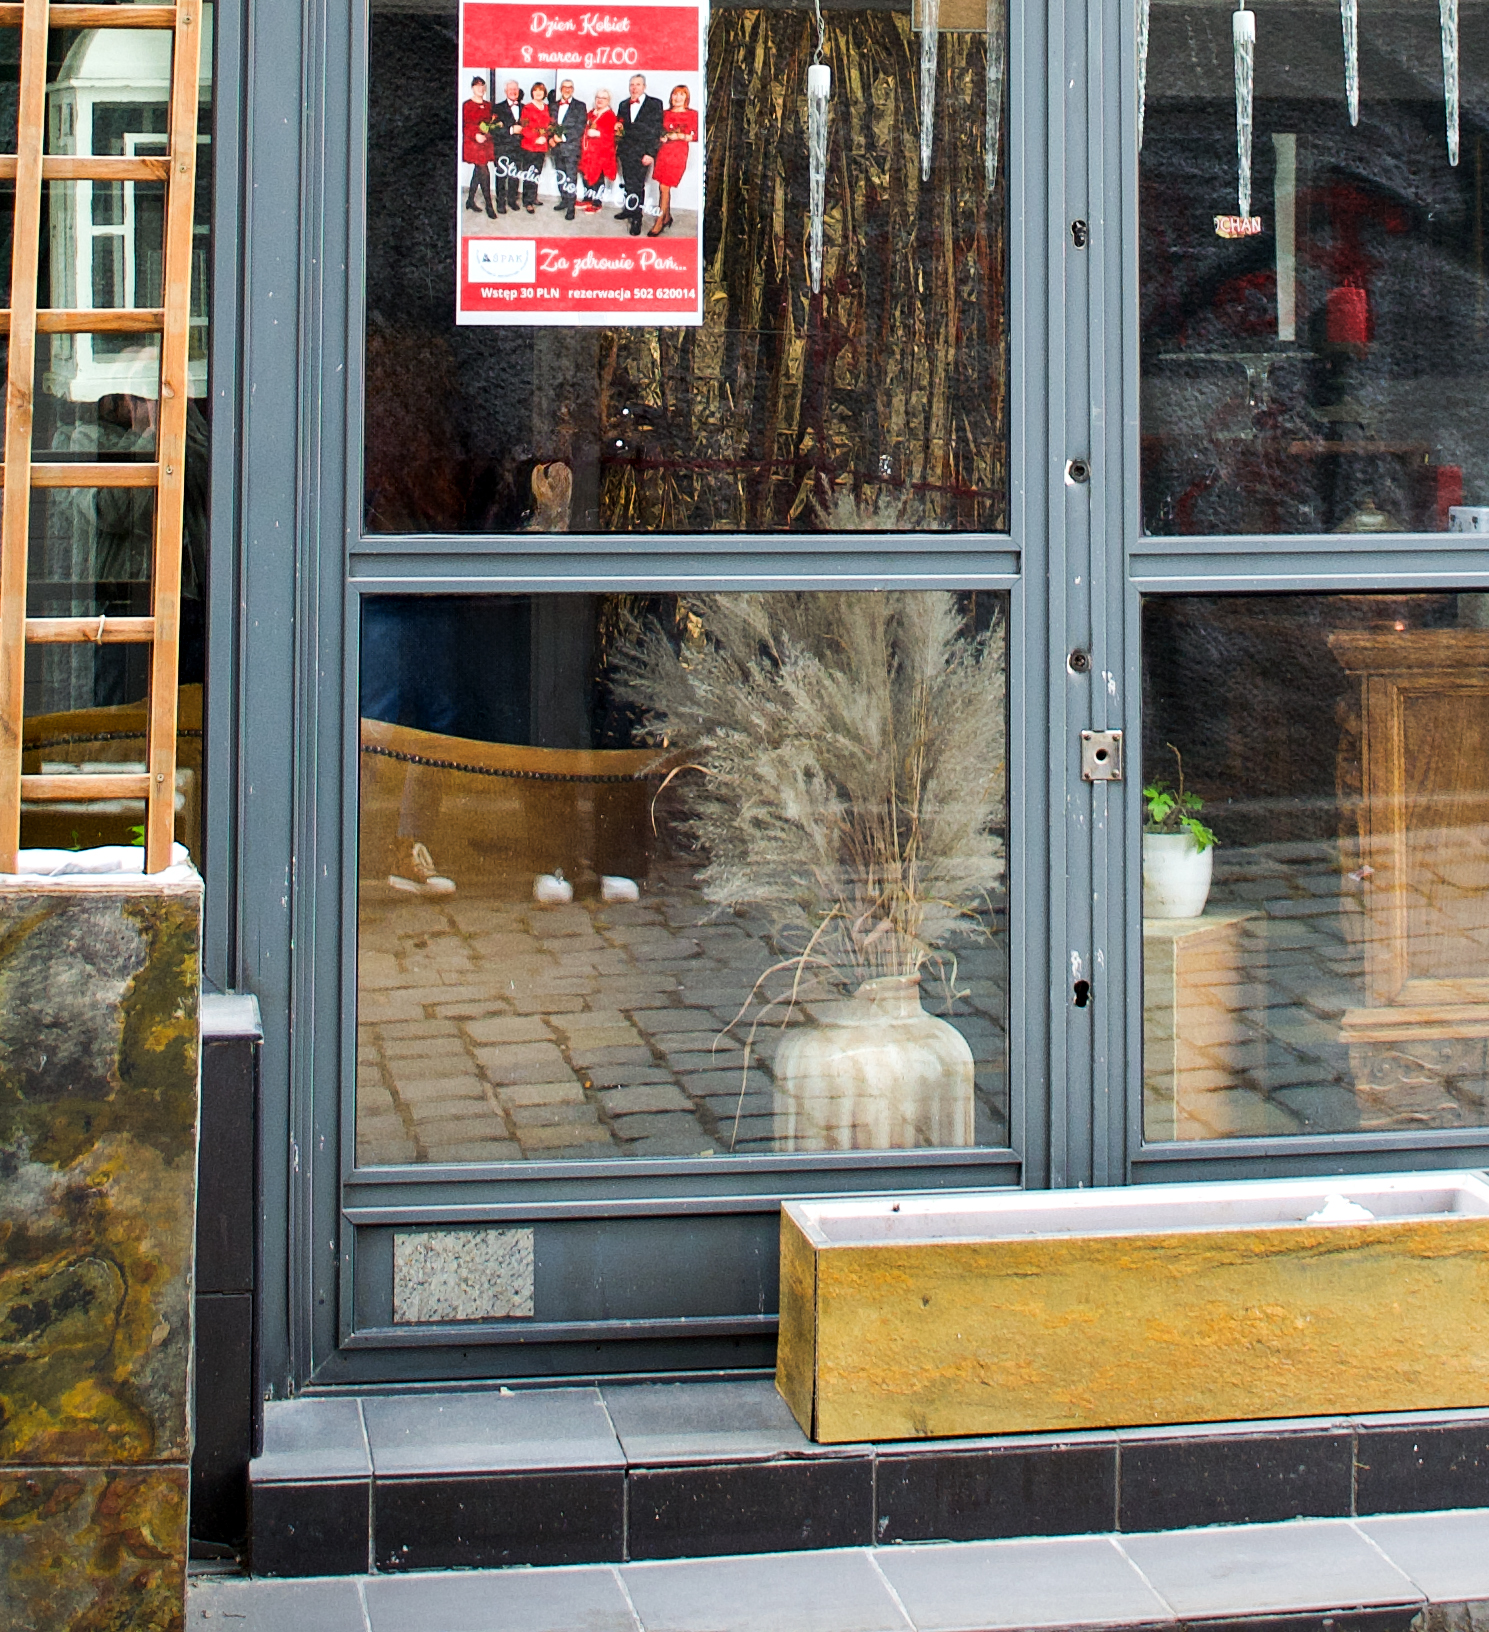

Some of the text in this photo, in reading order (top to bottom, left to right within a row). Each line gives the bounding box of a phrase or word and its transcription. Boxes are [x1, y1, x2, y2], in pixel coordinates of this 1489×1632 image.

[530, 12, 631, 38] Dzień Kobiet
[521, 45, 533, 63] 8
[537, 51, 582, 63] marca
[540, 248, 570, 272] Za
[572, 250, 634, 277] zdrowie
[480, 287, 696, 301] Wstęp 30 PLN rezerwacja 502 620014
